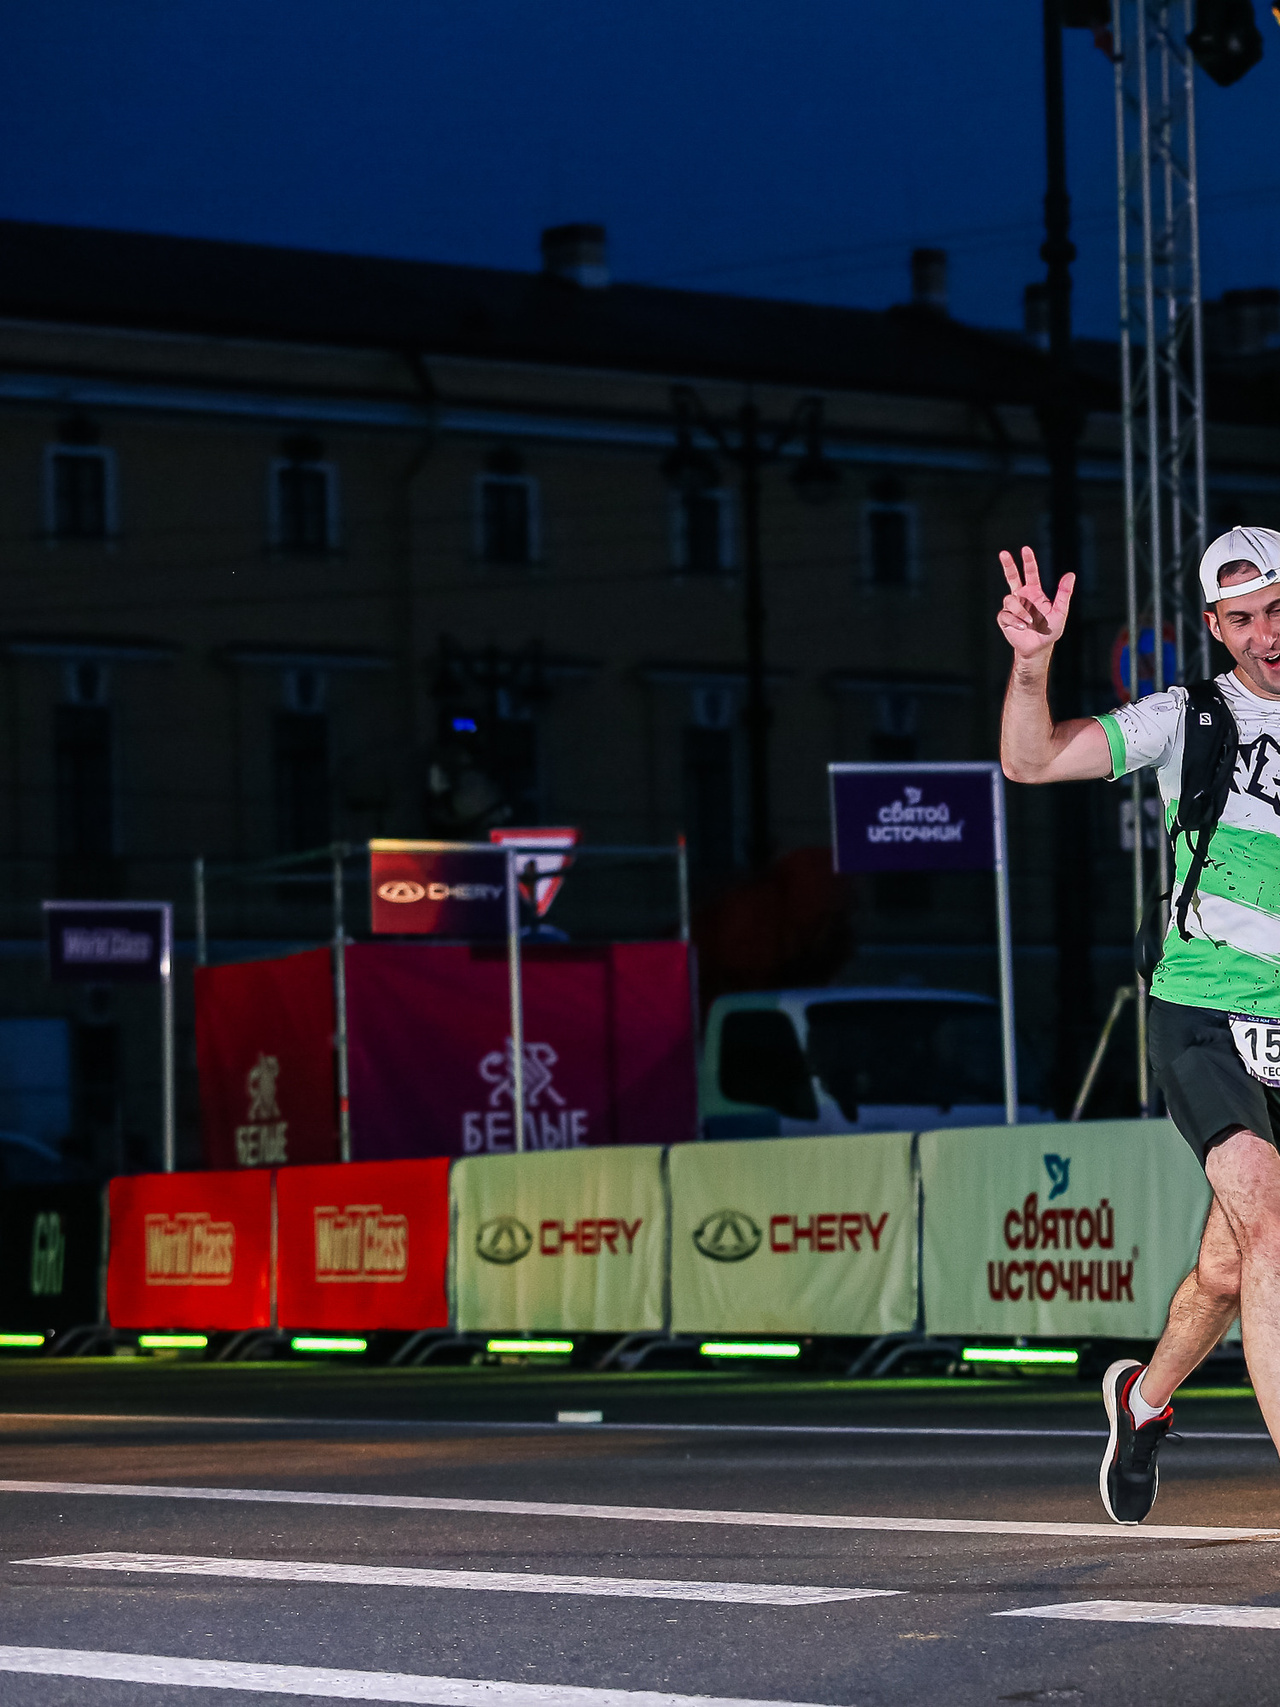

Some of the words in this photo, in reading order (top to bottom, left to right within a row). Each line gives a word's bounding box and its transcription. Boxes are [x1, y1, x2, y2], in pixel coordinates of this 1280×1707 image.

[428, 882, 504, 901] CHERY
[462, 1110, 588, 1153] БЕЛЫЕ
[317, 1208, 361, 1271] World
[363, 1212, 407, 1271] Class
[540, 1218, 643, 1256] CHERY
[769, 1213, 889, 1253] CHERY
[1003, 1191, 1114, 1250] святой
[147, 1216, 190, 1275] World
[191, 1220, 235, 1275] Class
[987, 1259, 1134, 1302] источник
